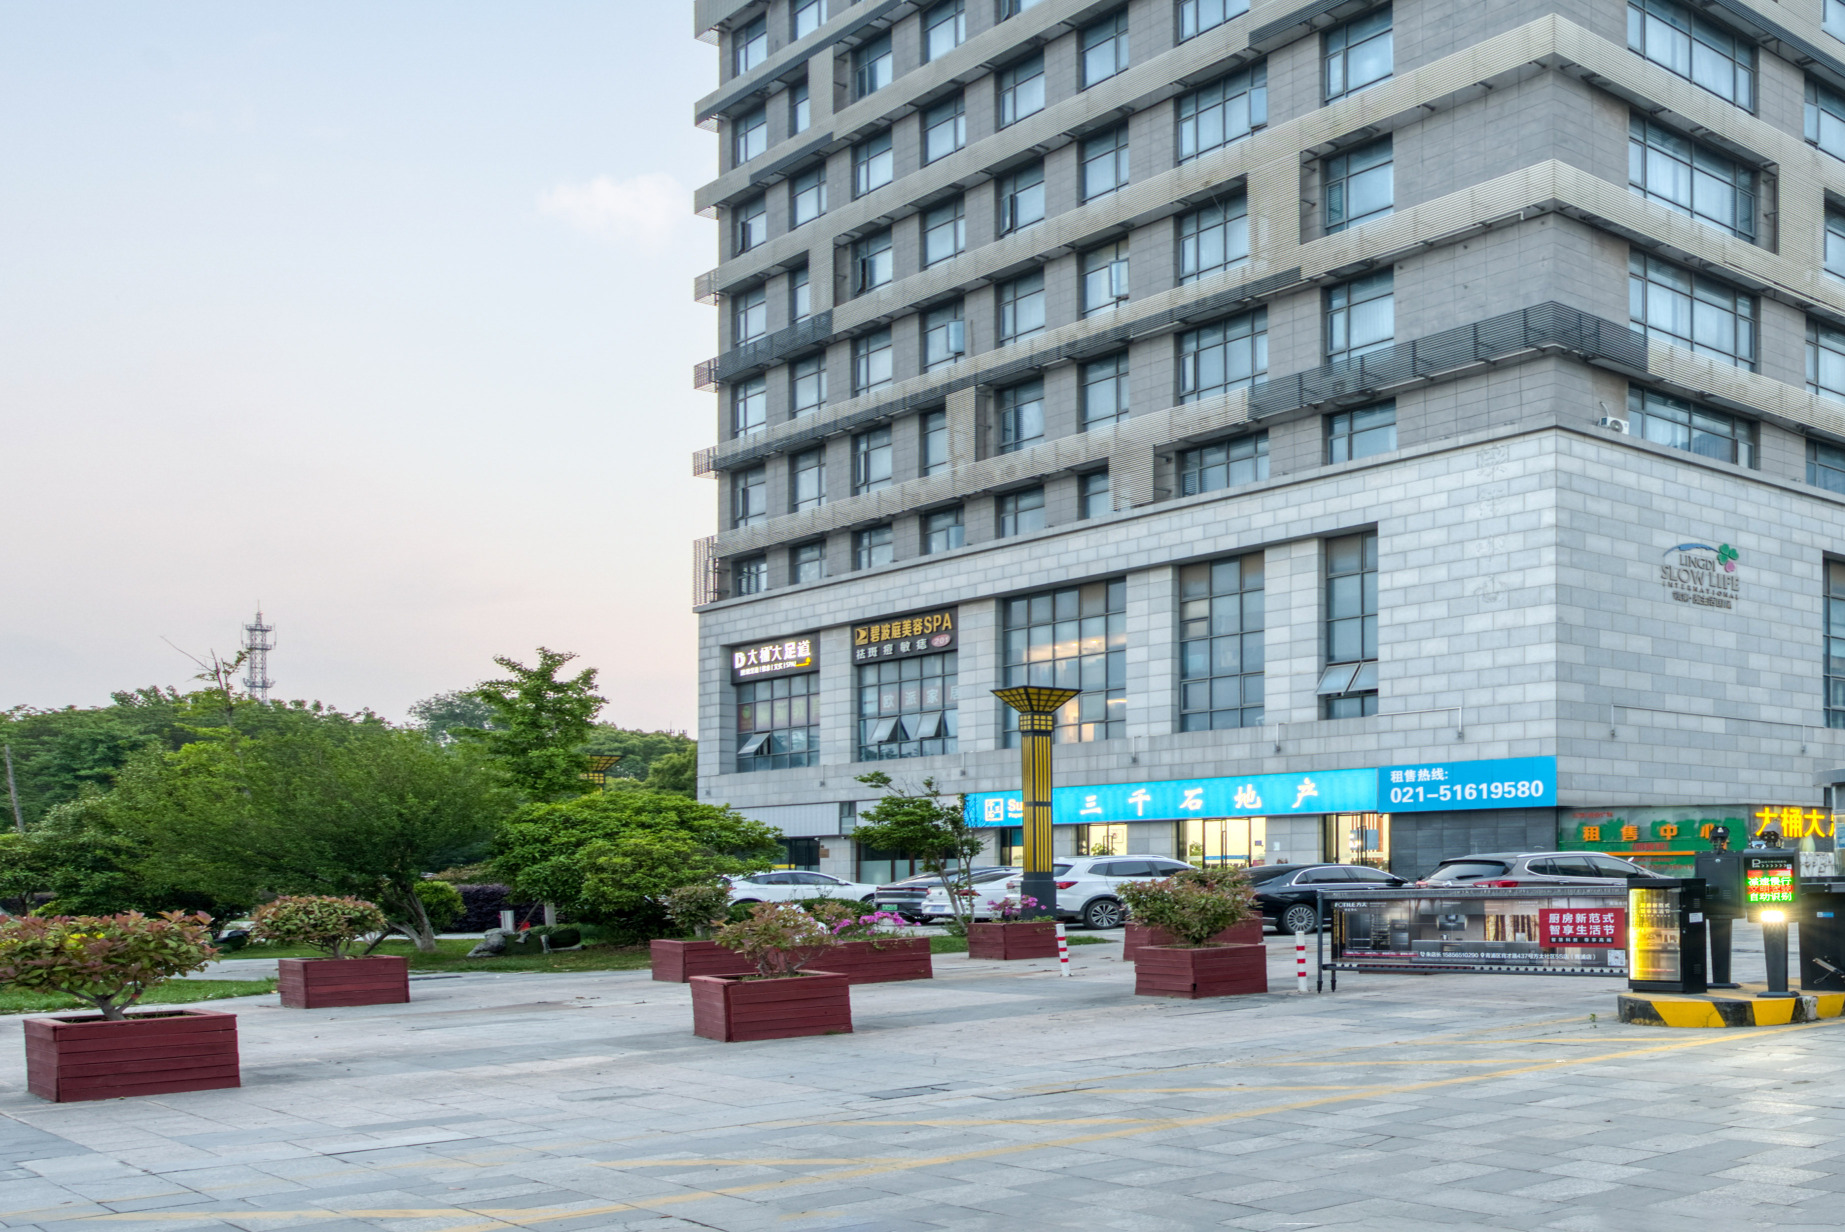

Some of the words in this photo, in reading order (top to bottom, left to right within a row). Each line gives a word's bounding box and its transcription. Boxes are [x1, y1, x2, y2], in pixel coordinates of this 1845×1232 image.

[1679, 554, 1716, 572] LINGDI
[1661, 565, 1705, 586] SLOW
[1709, 571, 1740, 592] LIFE
[1662, 581, 1739, 600] INTERNATIONAL
[870, 613, 953, 643] 碧波庭美容SPA
[1079, 778, 1319, 817] 三千石地产
[1390, 780, 1545, 804] 021-51619580
[1755, 807, 1835, 838] 大桶大
[1750, 893, 1793, 902] 自动识别
[1549, 913, 1615, 923] 厨房新范式
[1549, 925, 1615, 935] 智享生活节
